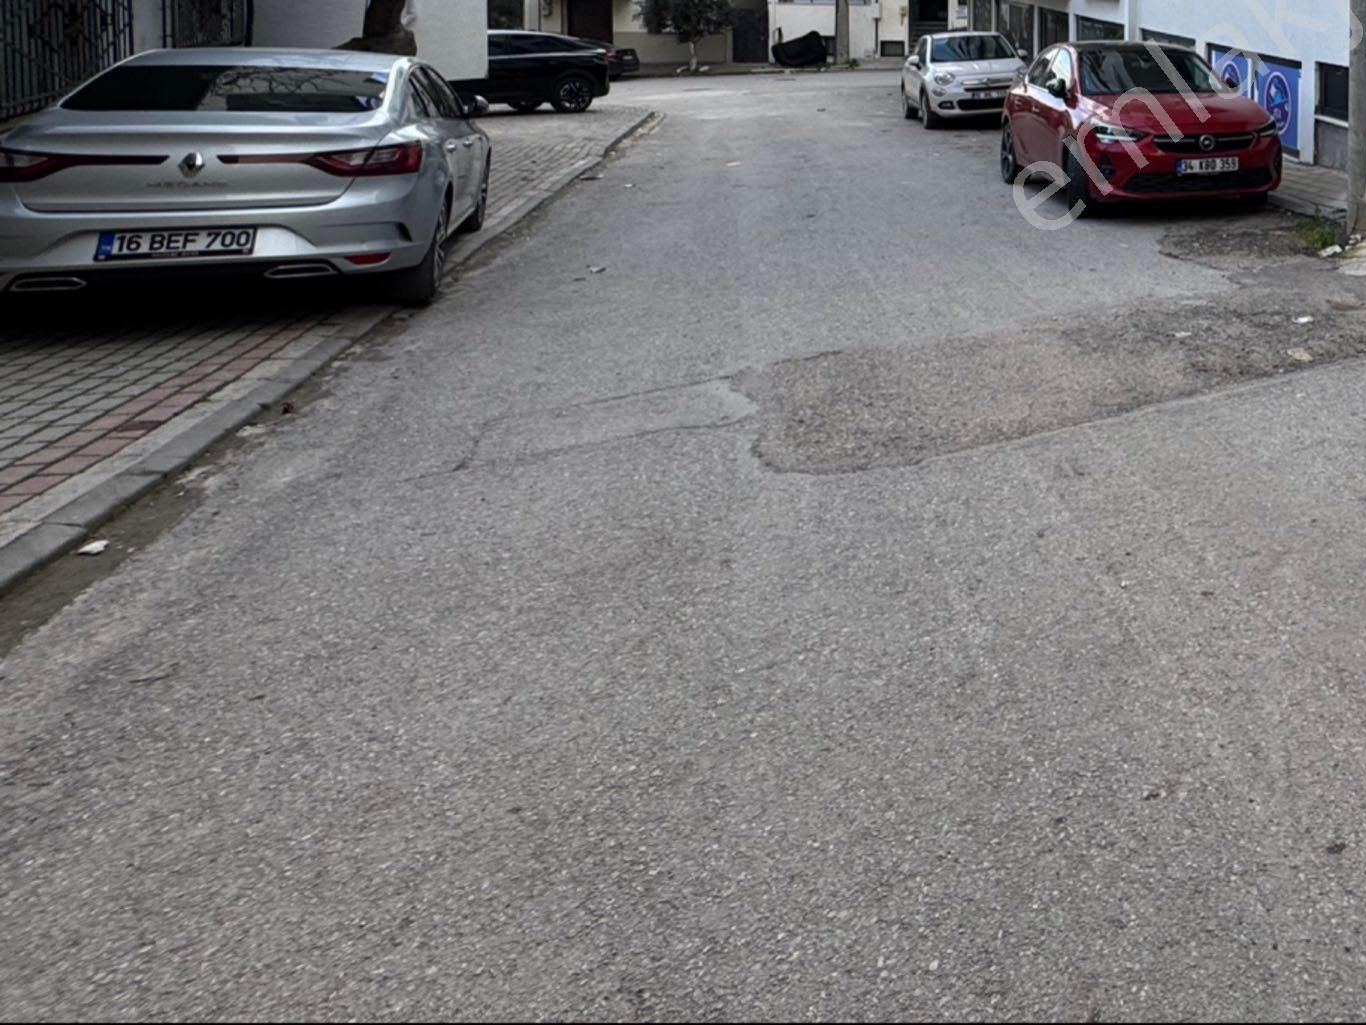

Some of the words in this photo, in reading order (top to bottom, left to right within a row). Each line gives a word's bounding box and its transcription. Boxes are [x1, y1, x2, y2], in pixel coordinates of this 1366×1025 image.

[116, 234, 144, 253] 16
[149, 232, 200, 251] BEF
[205, 230, 252, 249] 700
